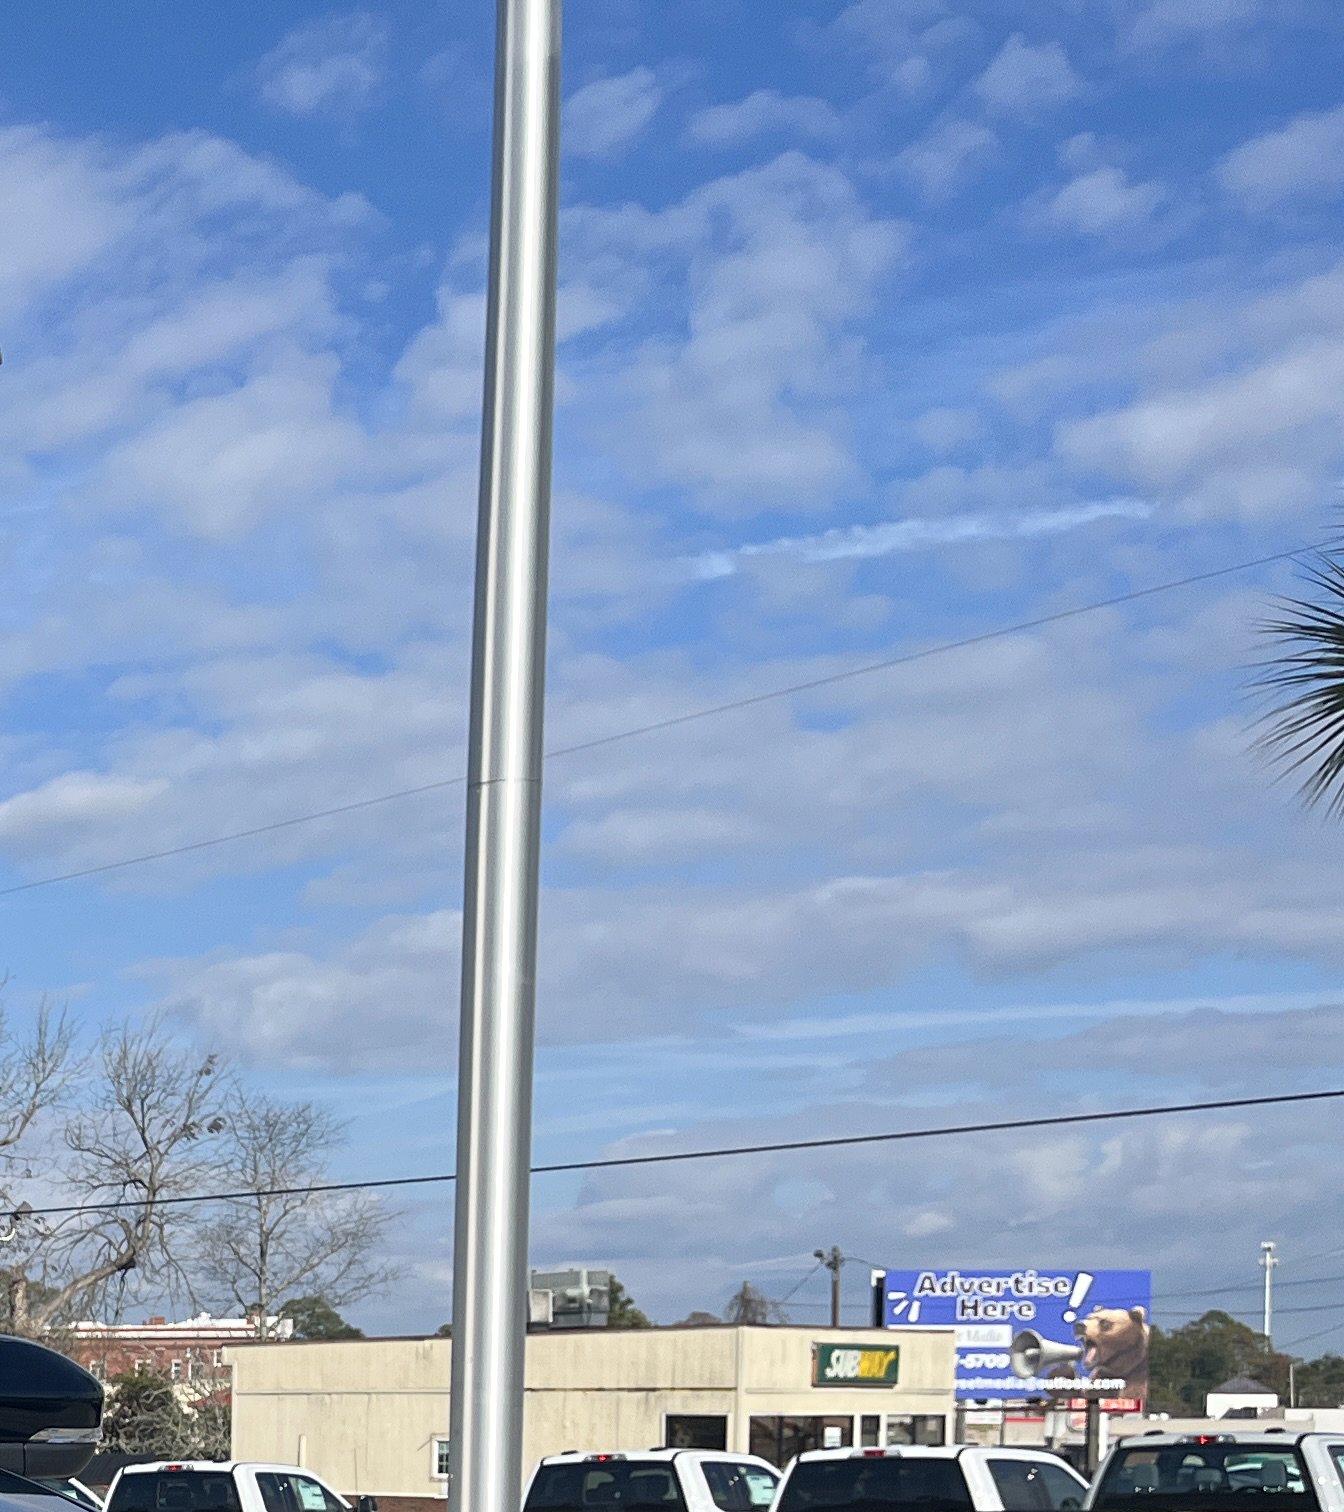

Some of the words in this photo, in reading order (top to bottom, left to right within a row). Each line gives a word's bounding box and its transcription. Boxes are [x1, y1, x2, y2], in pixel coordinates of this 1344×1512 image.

[916, 1271, 1071, 1295] Advertise
[958, 1297, 1034, 1318] Here
[825, 1349, 896, 1378] SUBWAY
